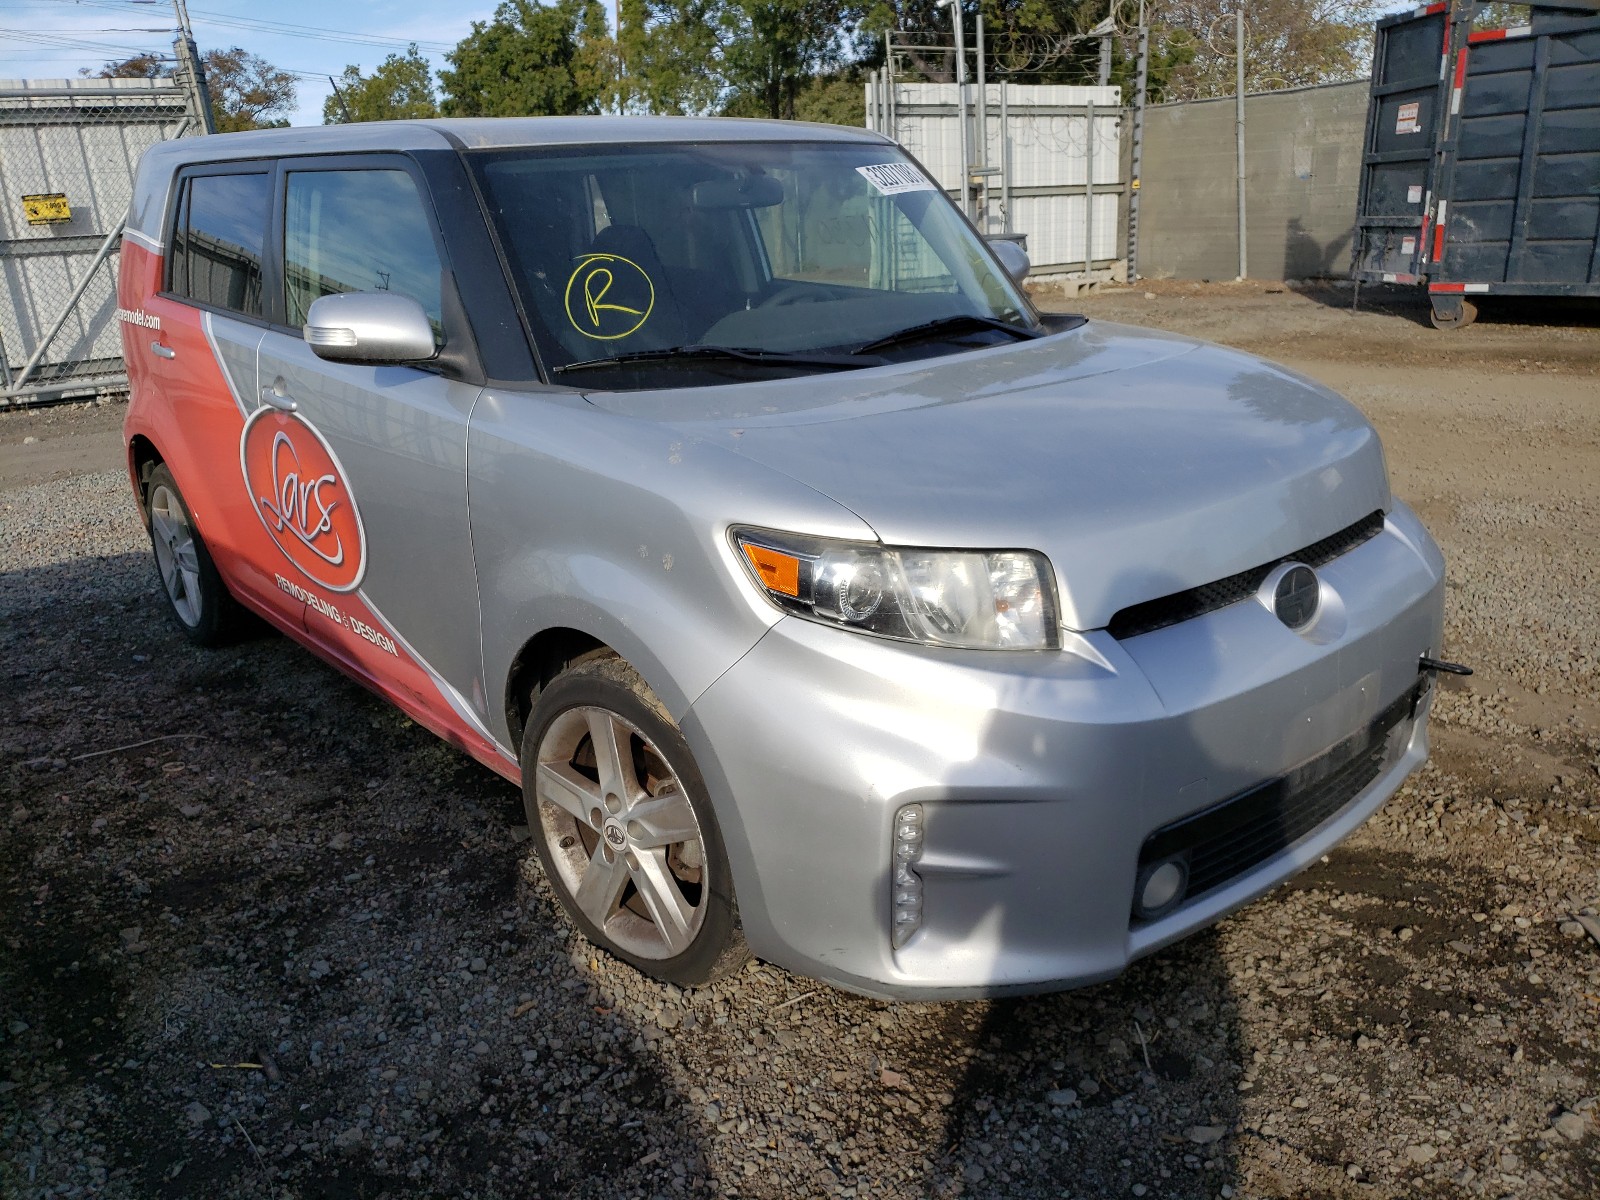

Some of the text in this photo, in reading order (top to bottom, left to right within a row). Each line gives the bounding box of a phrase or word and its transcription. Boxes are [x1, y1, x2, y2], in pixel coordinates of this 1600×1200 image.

[865, 163, 926, 187] 32071081
[583, 266, 646, 328] R
[274, 573, 342, 624] REMODELING
[349, 616, 399, 657] DESIGN
